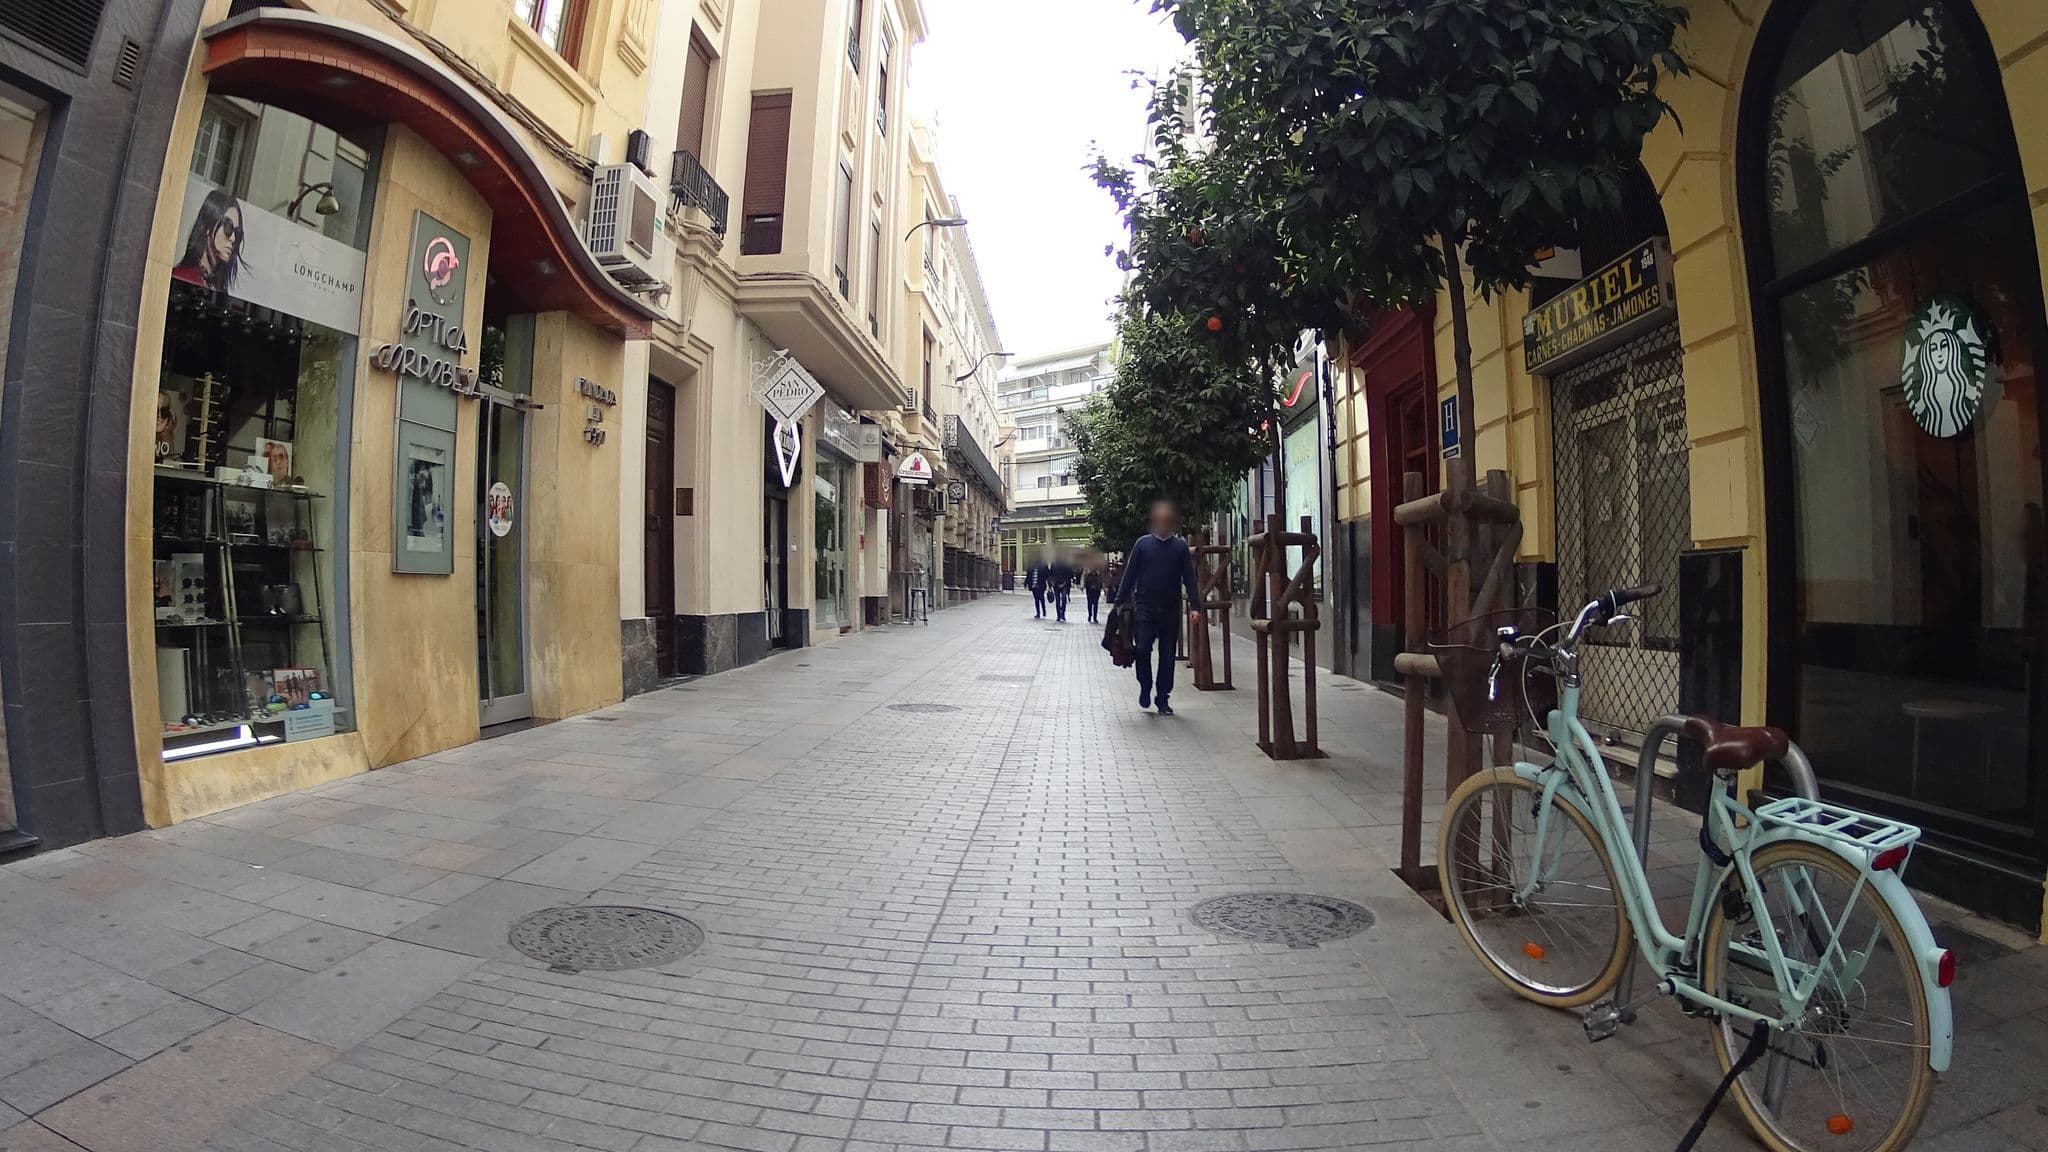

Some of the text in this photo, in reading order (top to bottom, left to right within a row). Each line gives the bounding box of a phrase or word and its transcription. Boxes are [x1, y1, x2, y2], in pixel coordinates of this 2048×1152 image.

[294, 263, 355, 294] LONGCHAMP
[1534, 257, 1643, 342] MURIEL
[773, 387, 809, 398] PEDRO
[780, 379, 800, 389] SAN
[1444, 402, 1455, 432] H
